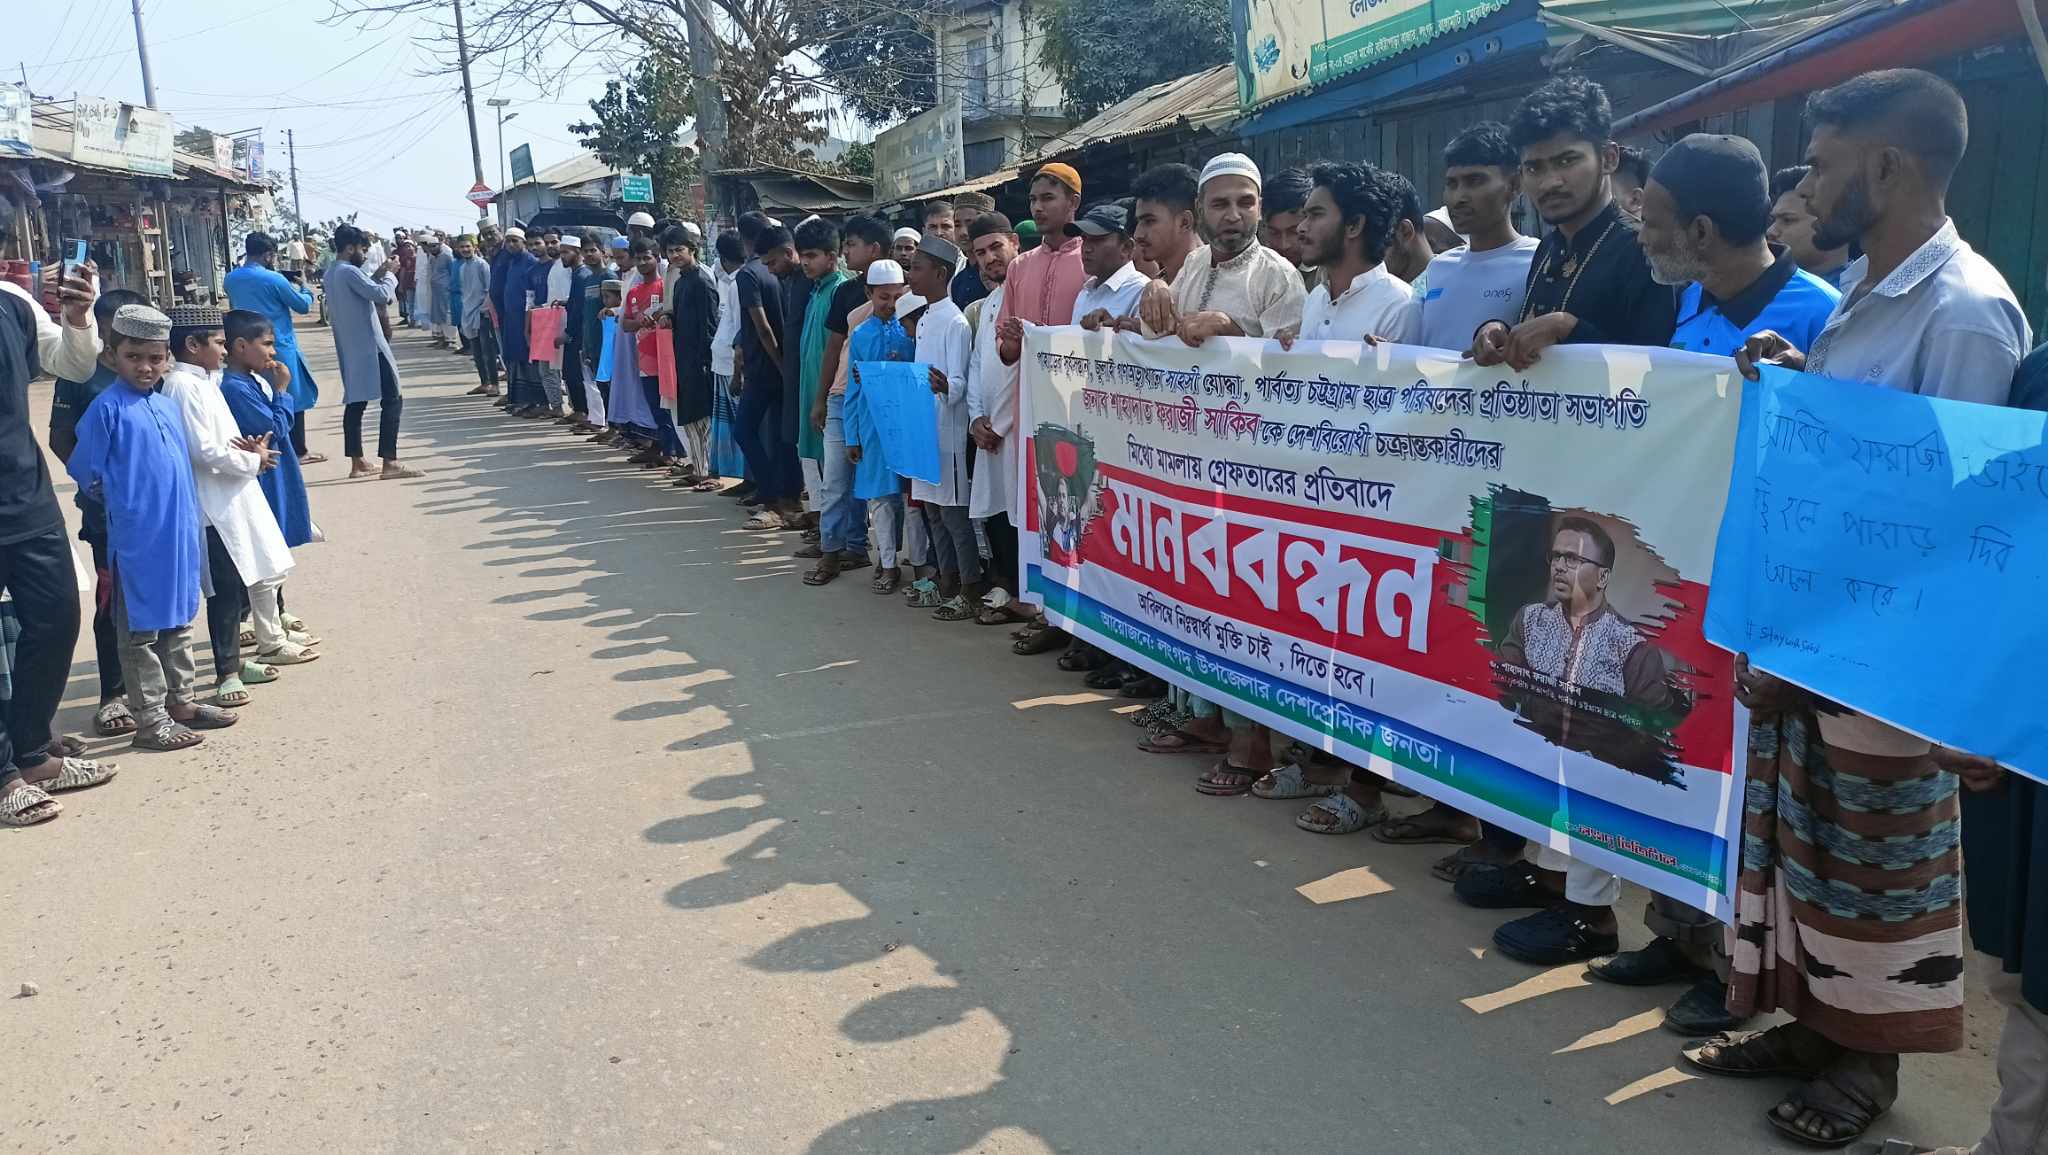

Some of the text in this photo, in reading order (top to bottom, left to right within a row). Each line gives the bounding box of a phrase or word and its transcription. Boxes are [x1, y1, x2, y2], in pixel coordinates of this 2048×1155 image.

[1082, 388, 1109, 418] জনাব
[1155, 395, 1201, 435] ফরাজী
[1288, 419, 1371, 457] দেশবিরোধী
[1375, 428, 1505, 471] চক্রান্তকারীদের
[1165, 365, 1201, 396] সাহসী
[1255, 369, 1304, 404] পার্বত্য
[1308, 374, 1360, 411] চট্টগ্রাম
[1363, 384, 1398, 414] ছাত্র
[1400, 379, 1475, 417] পরিষদের
[1480, 379, 1560, 422] প্রতিষ্ঠাতা
[1566, 387, 1650, 430] সভাপতি
[1127, 433, 1396, 512] মিথ্যে মামলায় গ্রেফতারের প্রতিবাদে
[1106, 478, 1440, 653] মানববন্ধন
[1137, 592, 1174, 626] অবিলম্বে
[1215, 622, 1244, 654] মুক্তি
[1290, 642, 1329, 679] দিতে
[1156, 637, 1194, 676] লংগদু
[1195, 647, 1271, 702] উপজেলার
[1276, 687, 1375, 740] দেশপ্রেমিক
